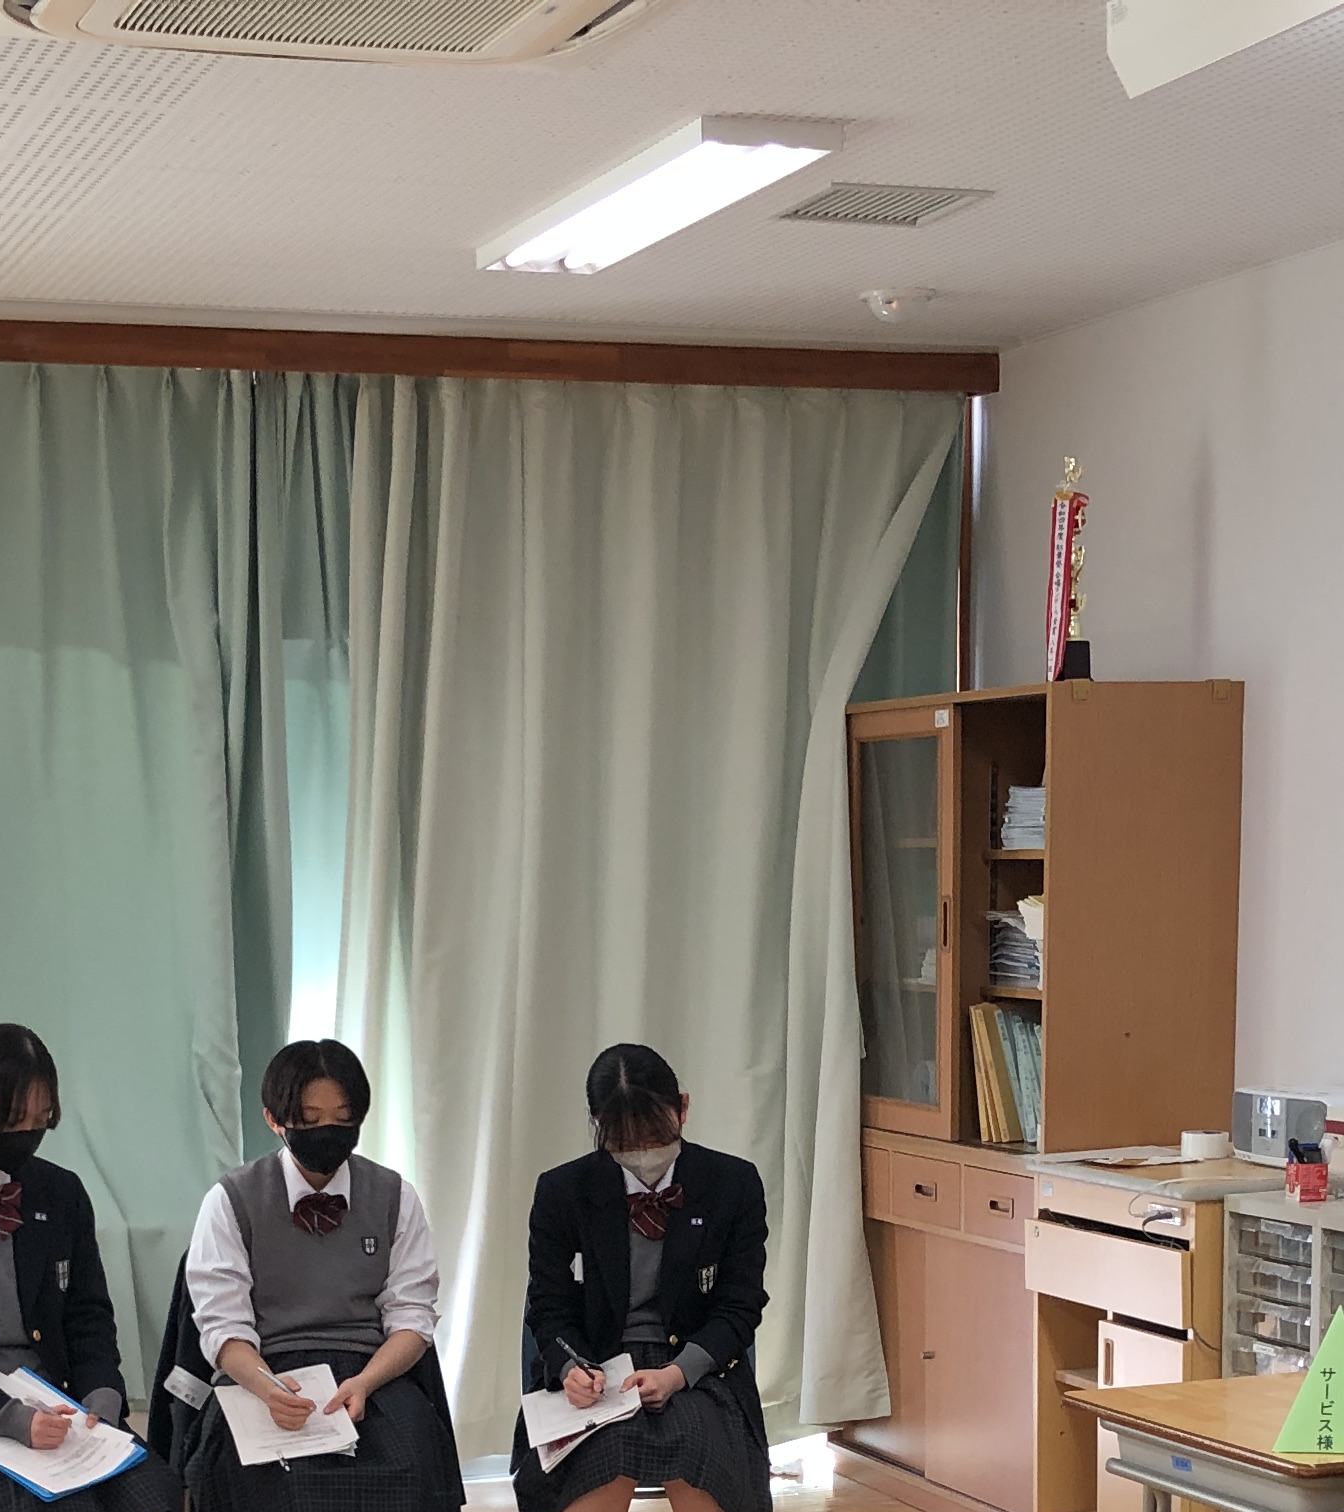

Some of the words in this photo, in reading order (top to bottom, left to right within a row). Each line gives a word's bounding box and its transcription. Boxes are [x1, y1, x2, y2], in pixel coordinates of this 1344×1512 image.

[1316, 1367, 1336, 1450] サービス様
